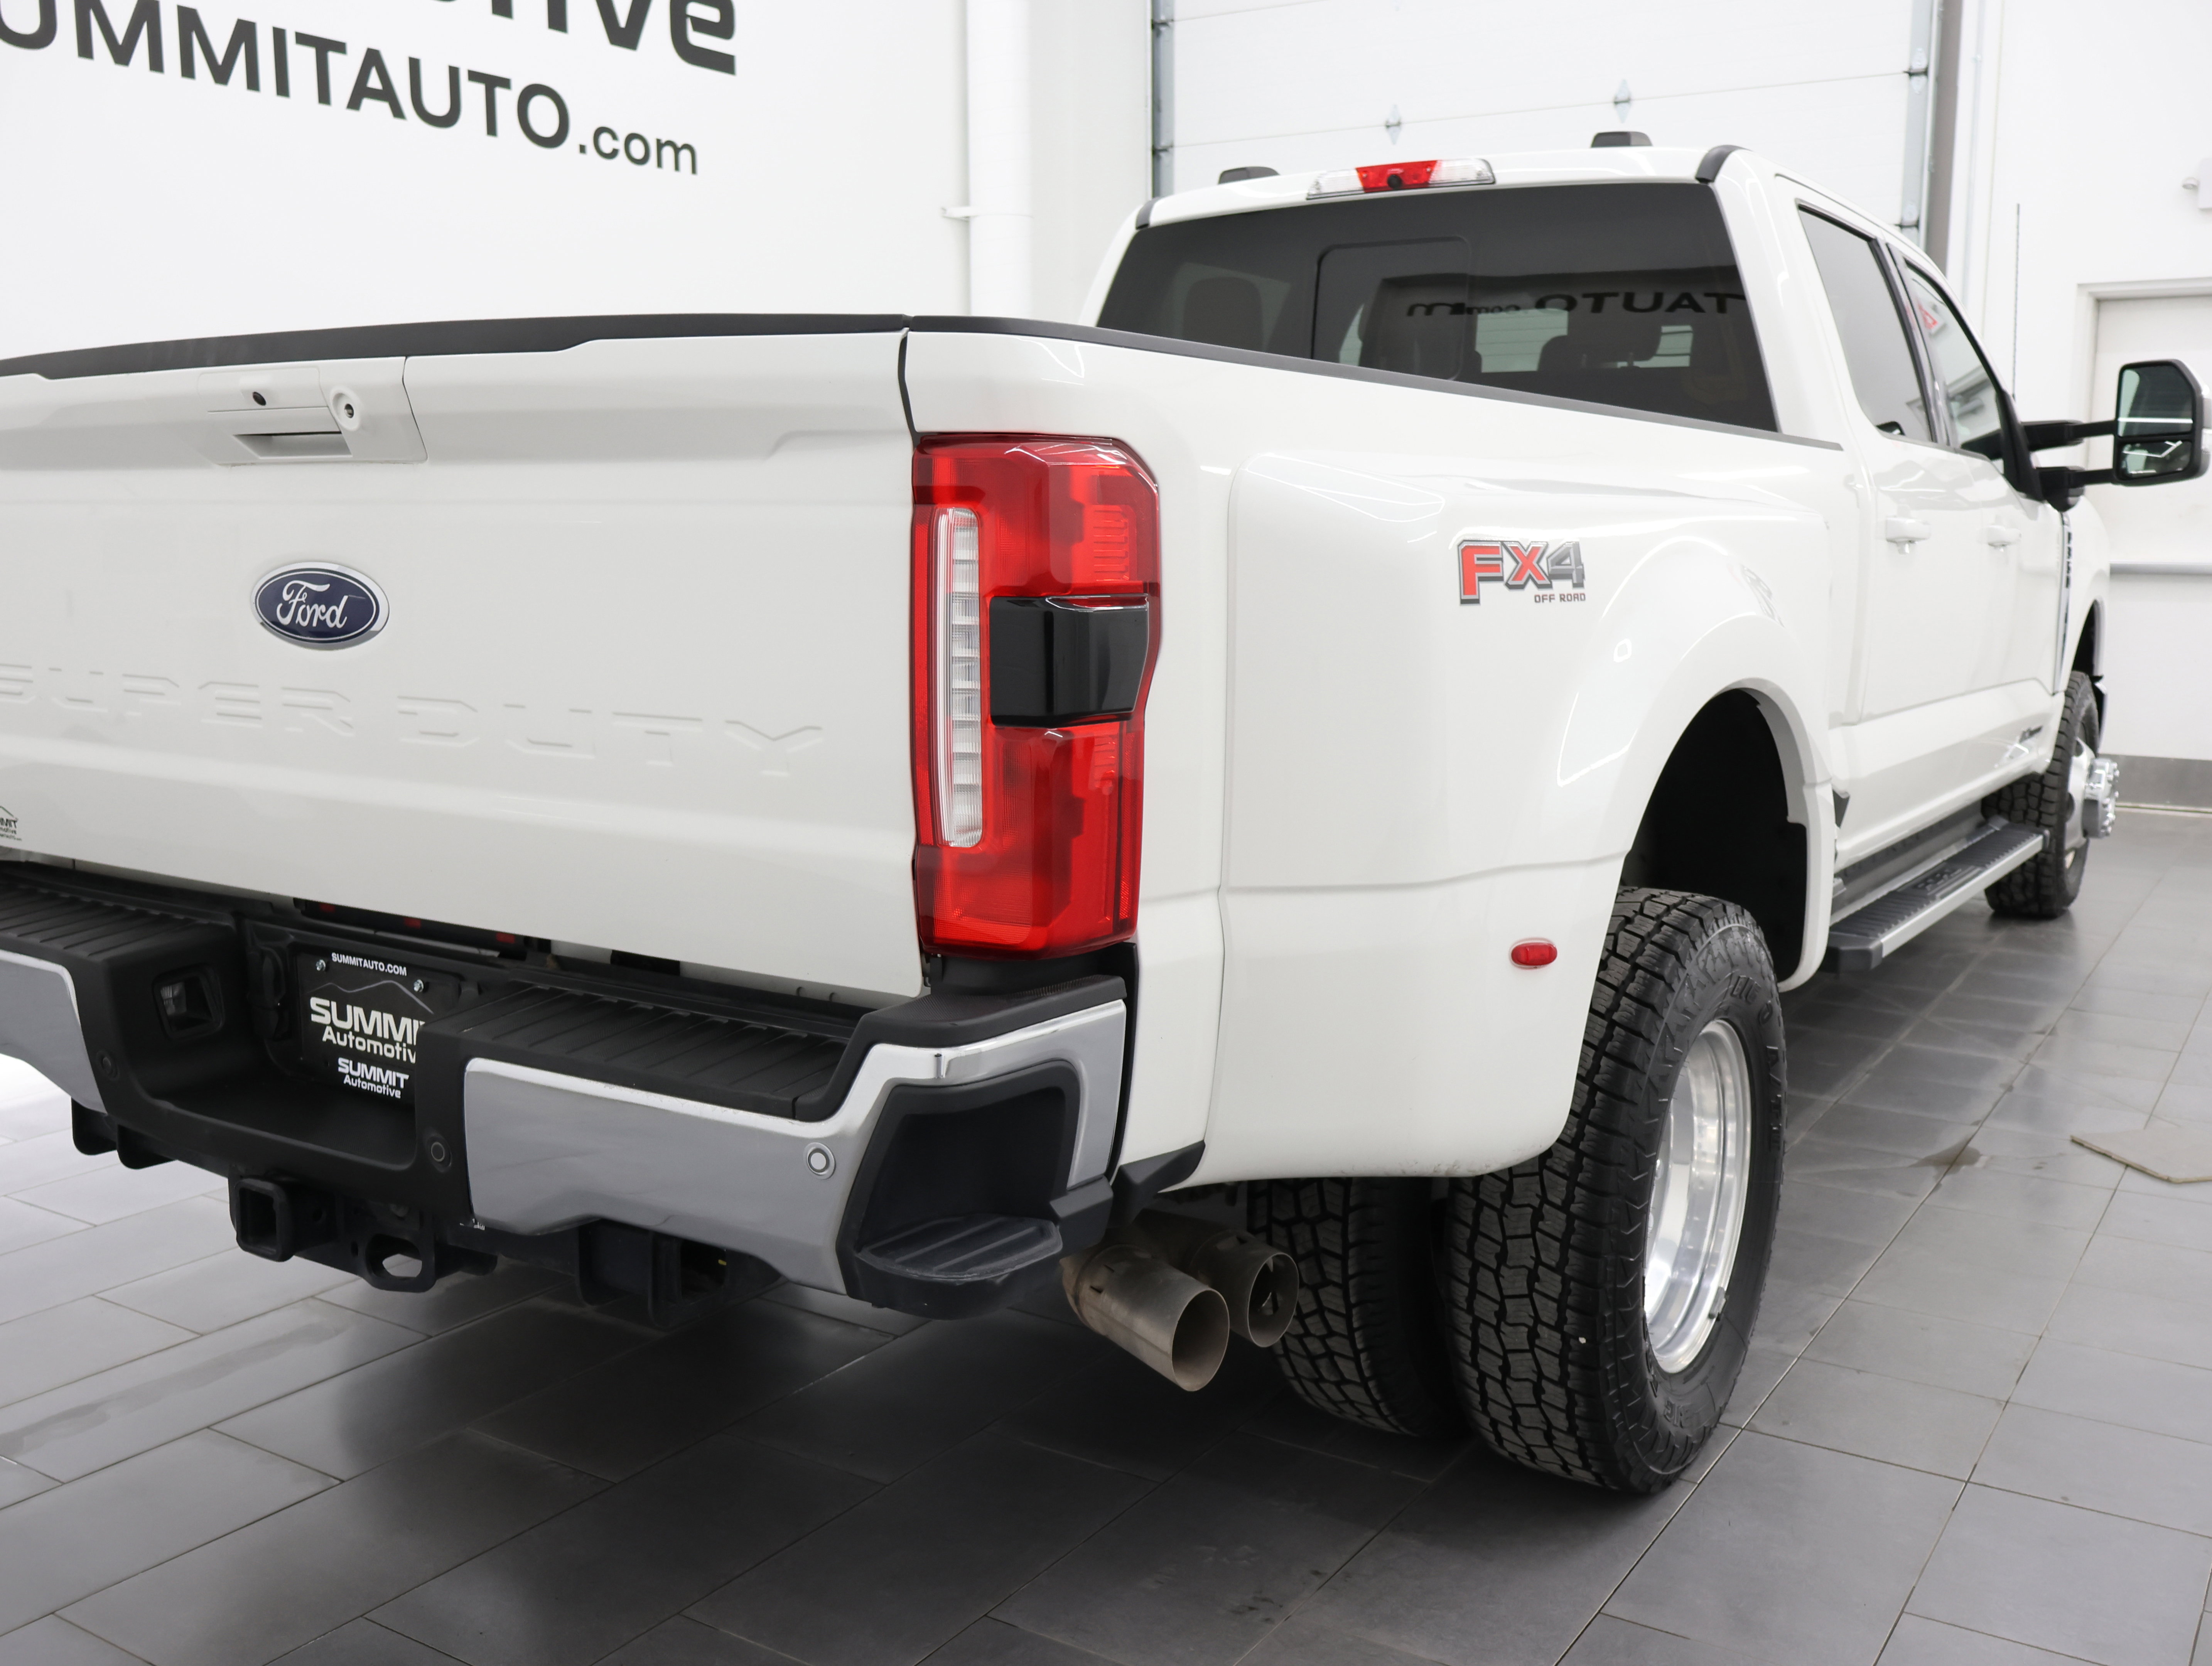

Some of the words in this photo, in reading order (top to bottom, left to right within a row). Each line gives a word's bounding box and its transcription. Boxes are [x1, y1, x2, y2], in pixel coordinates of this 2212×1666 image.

[1458, 540, 1585, 605] FX4
[277, 580, 348, 628] Ford
[1534, 594, 1555, 603] OFF
[1560, 593, 1586, 602] ROAD
[397, 696, 824, 776] DUTY
[332, 953, 407, 976] SUMMITAUTO.COM
[310, 997, 425, 1046] SUMMI
[322, 1026, 416, 1064] Automotiv
[338, 1057, 409, 1089] SUMMIT
[344, 1074, 401, 1099] Automotive
